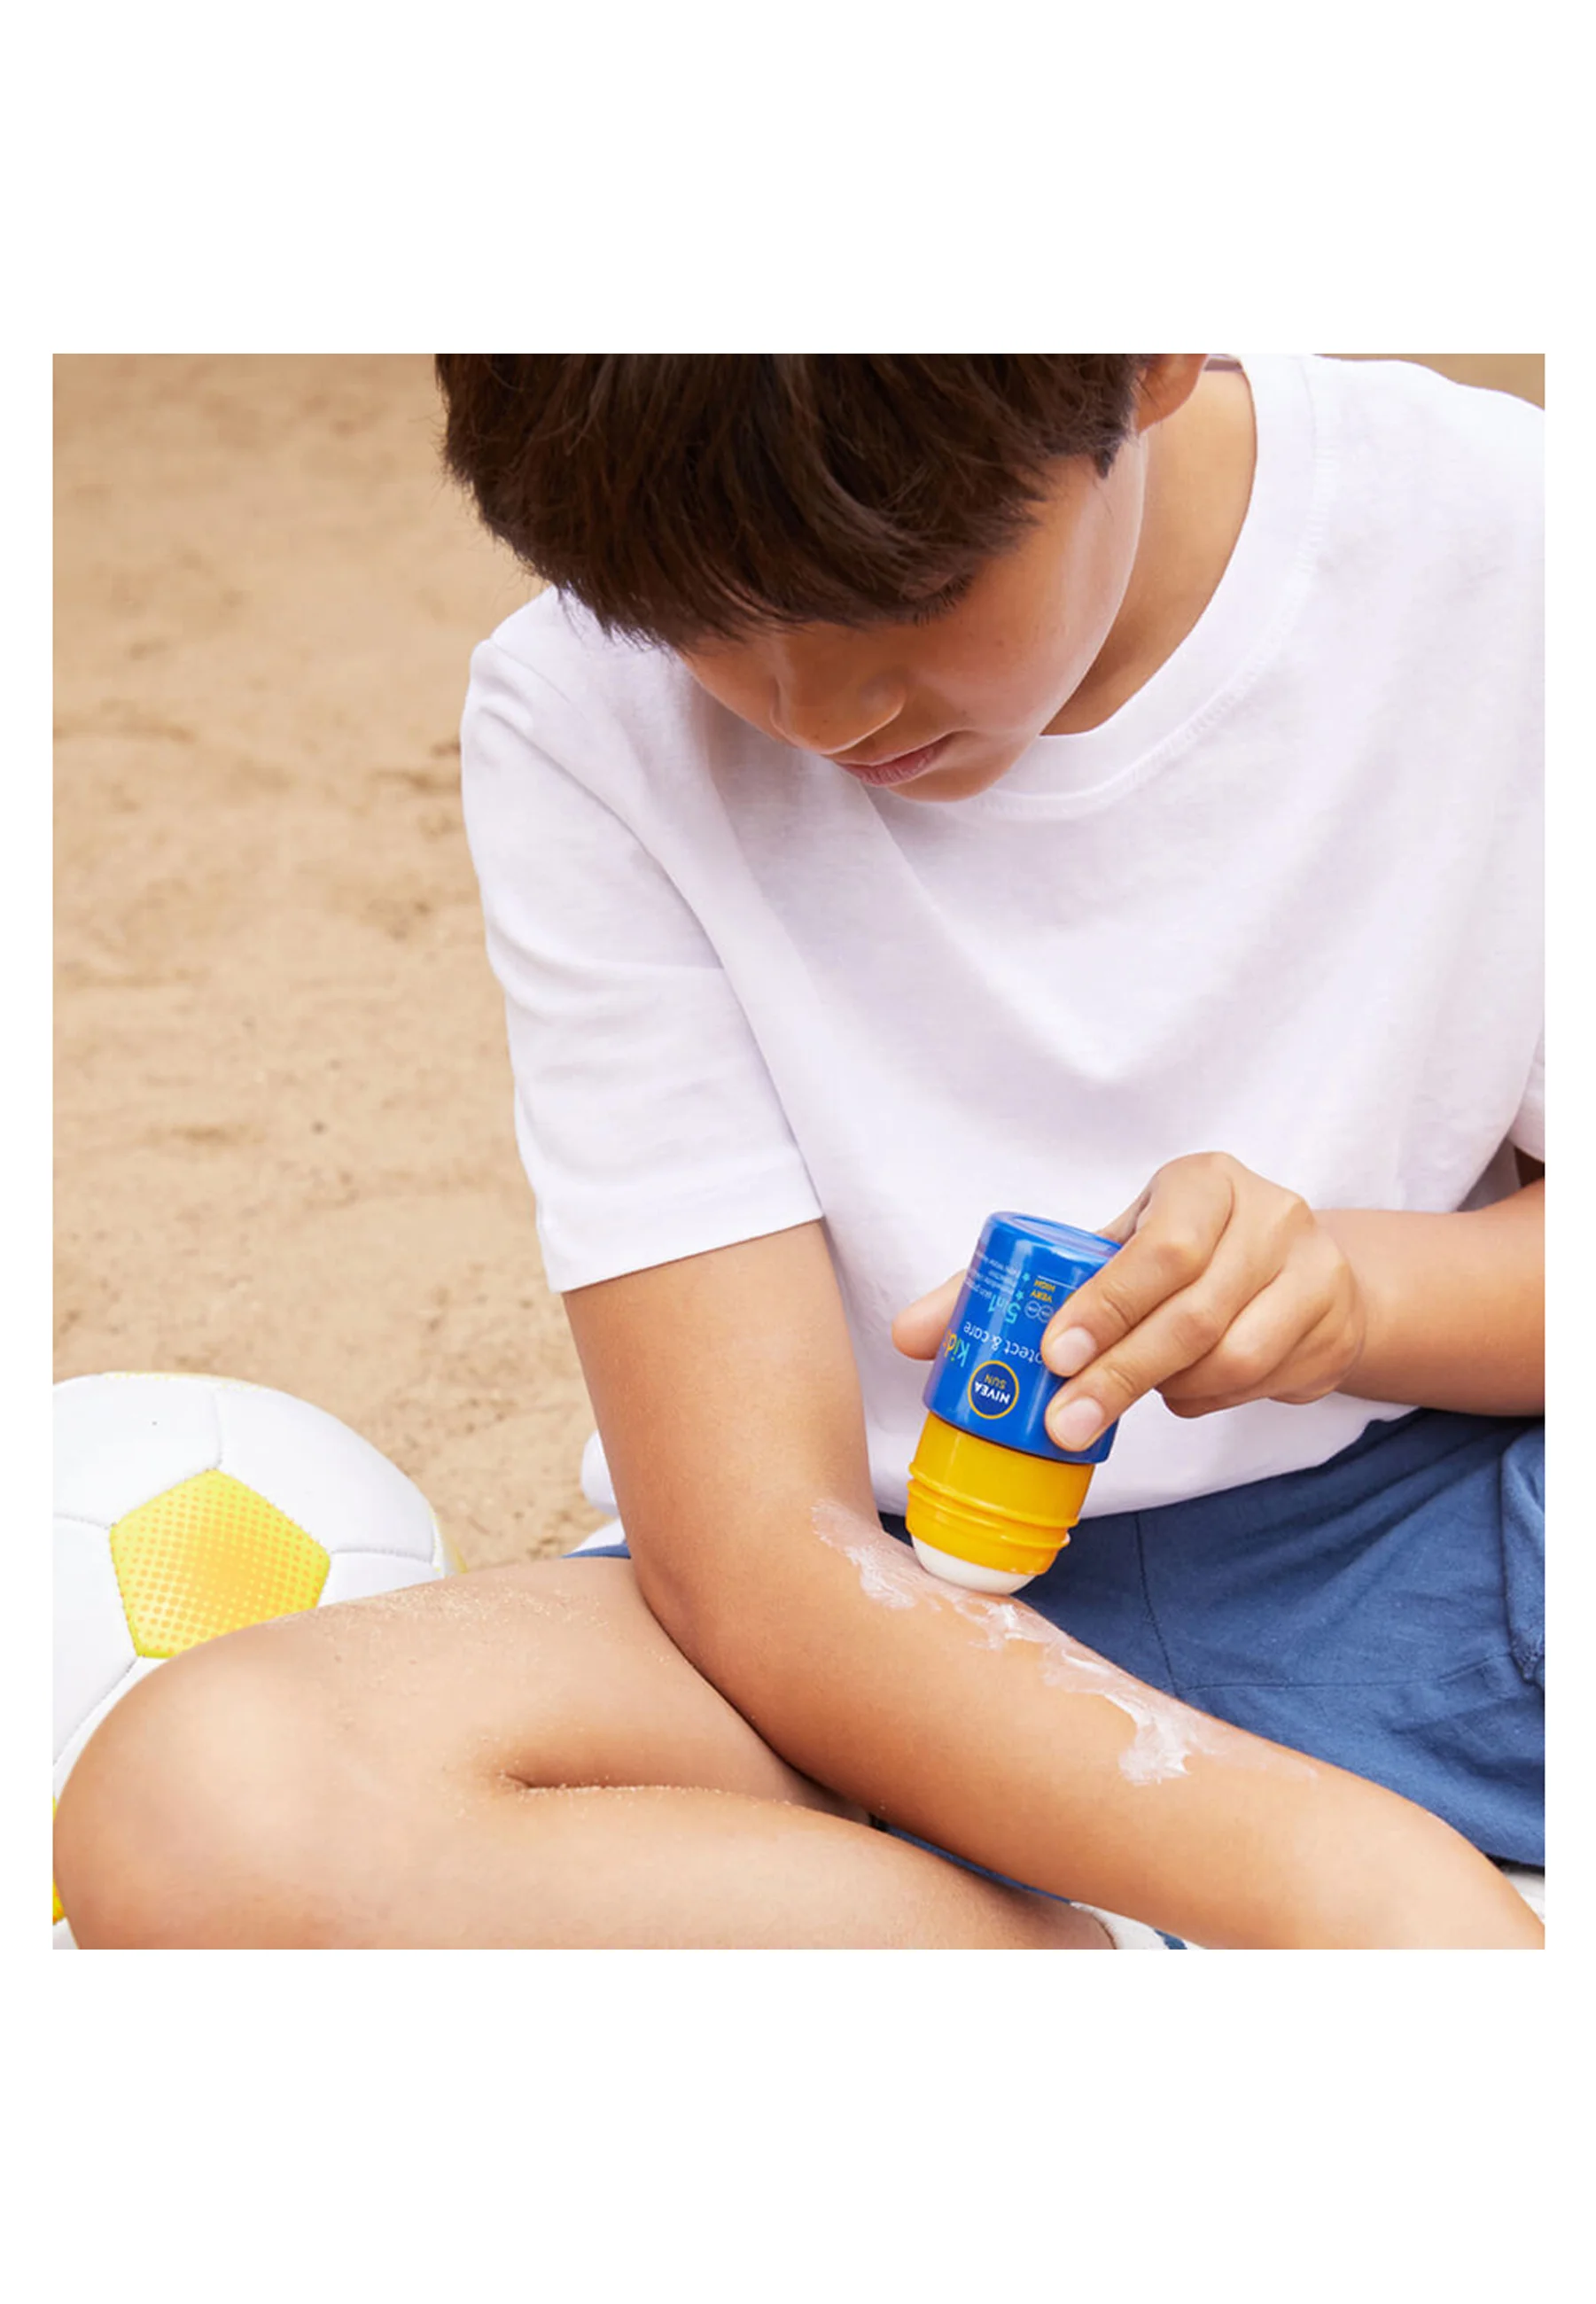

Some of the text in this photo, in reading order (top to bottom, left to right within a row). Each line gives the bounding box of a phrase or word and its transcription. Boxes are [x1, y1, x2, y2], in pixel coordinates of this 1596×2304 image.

[1030, 1289, 1053, 1304] VERY
[962, 1321, 1044, 1364] otect & care
[984, 1374, 1007, 1390] SUN
[974, 1381, 1011, 1404] NIVEA
